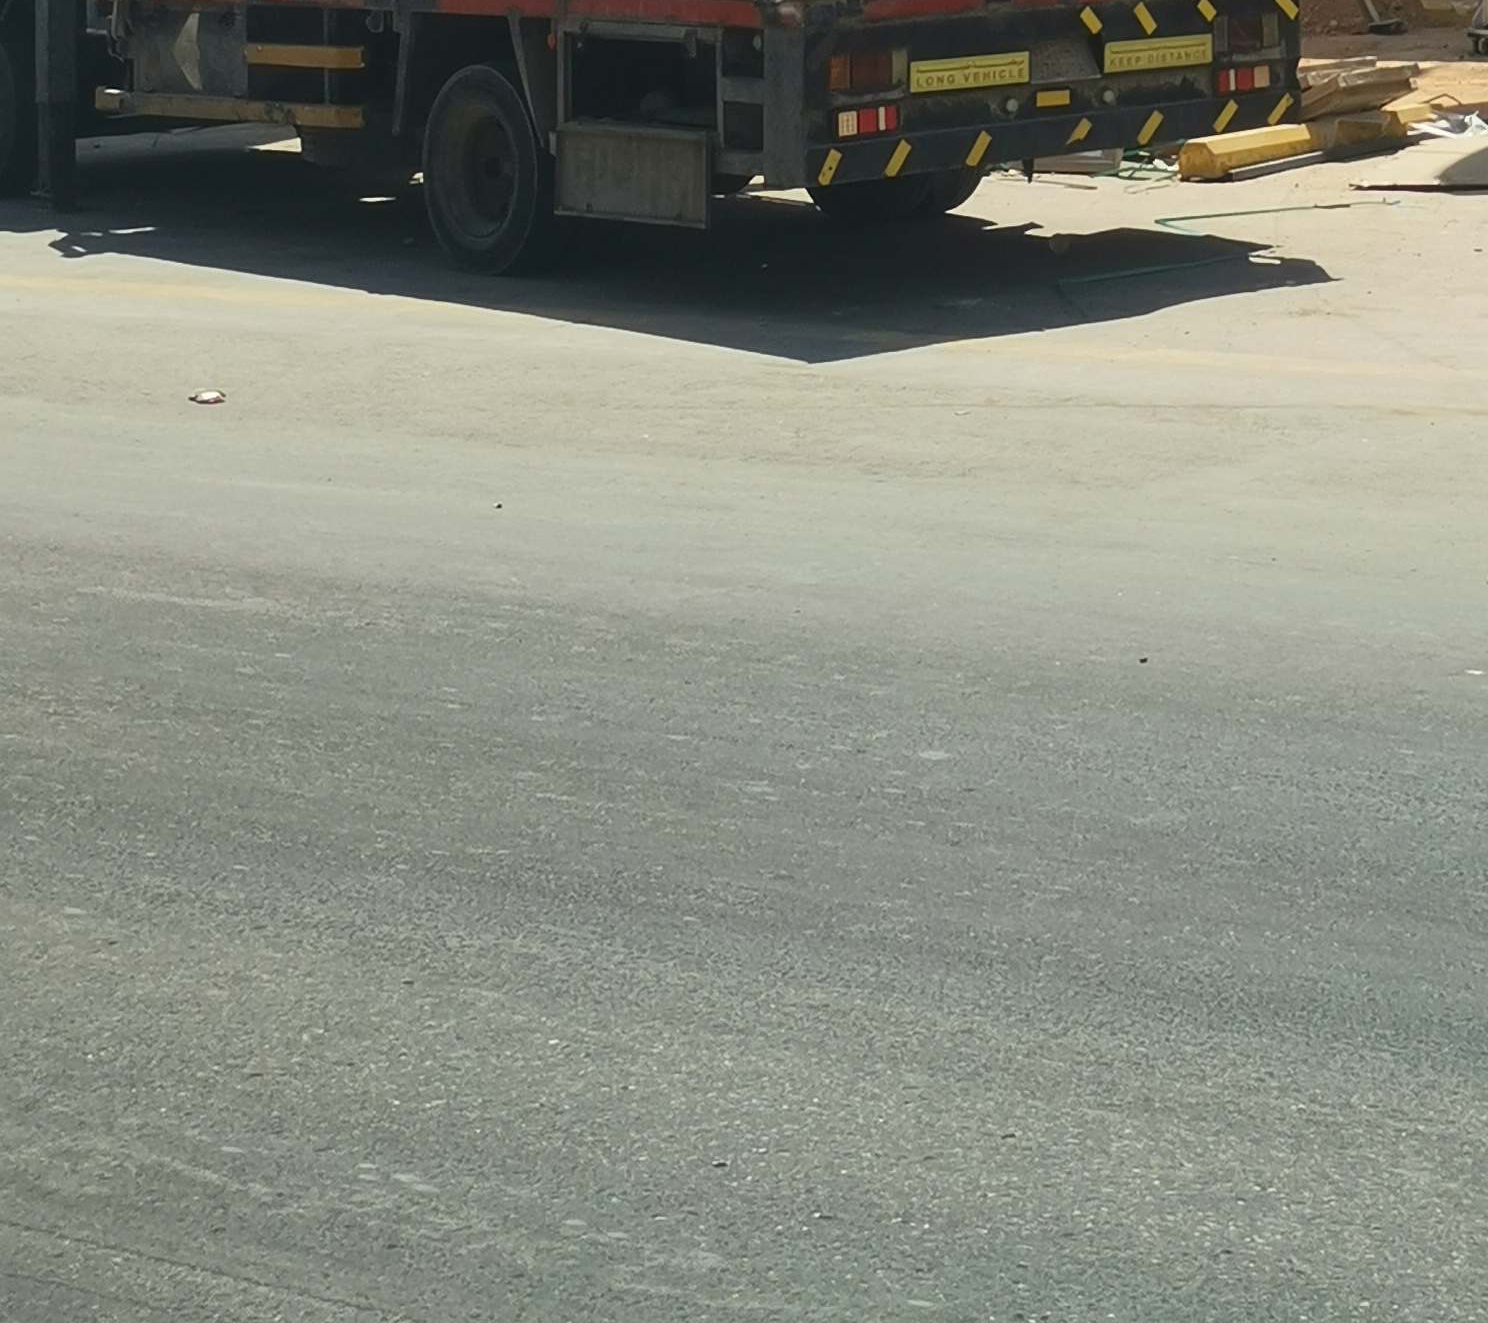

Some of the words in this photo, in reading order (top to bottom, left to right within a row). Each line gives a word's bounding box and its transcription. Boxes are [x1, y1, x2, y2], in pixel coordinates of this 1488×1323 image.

[1109, 56, 1142, 67] KEEP
[1147, 48, 1209, 65] DISTANCE
[916, 74, 956, 88] LONG
[962, 68, 1024, 84] VEHICLE
